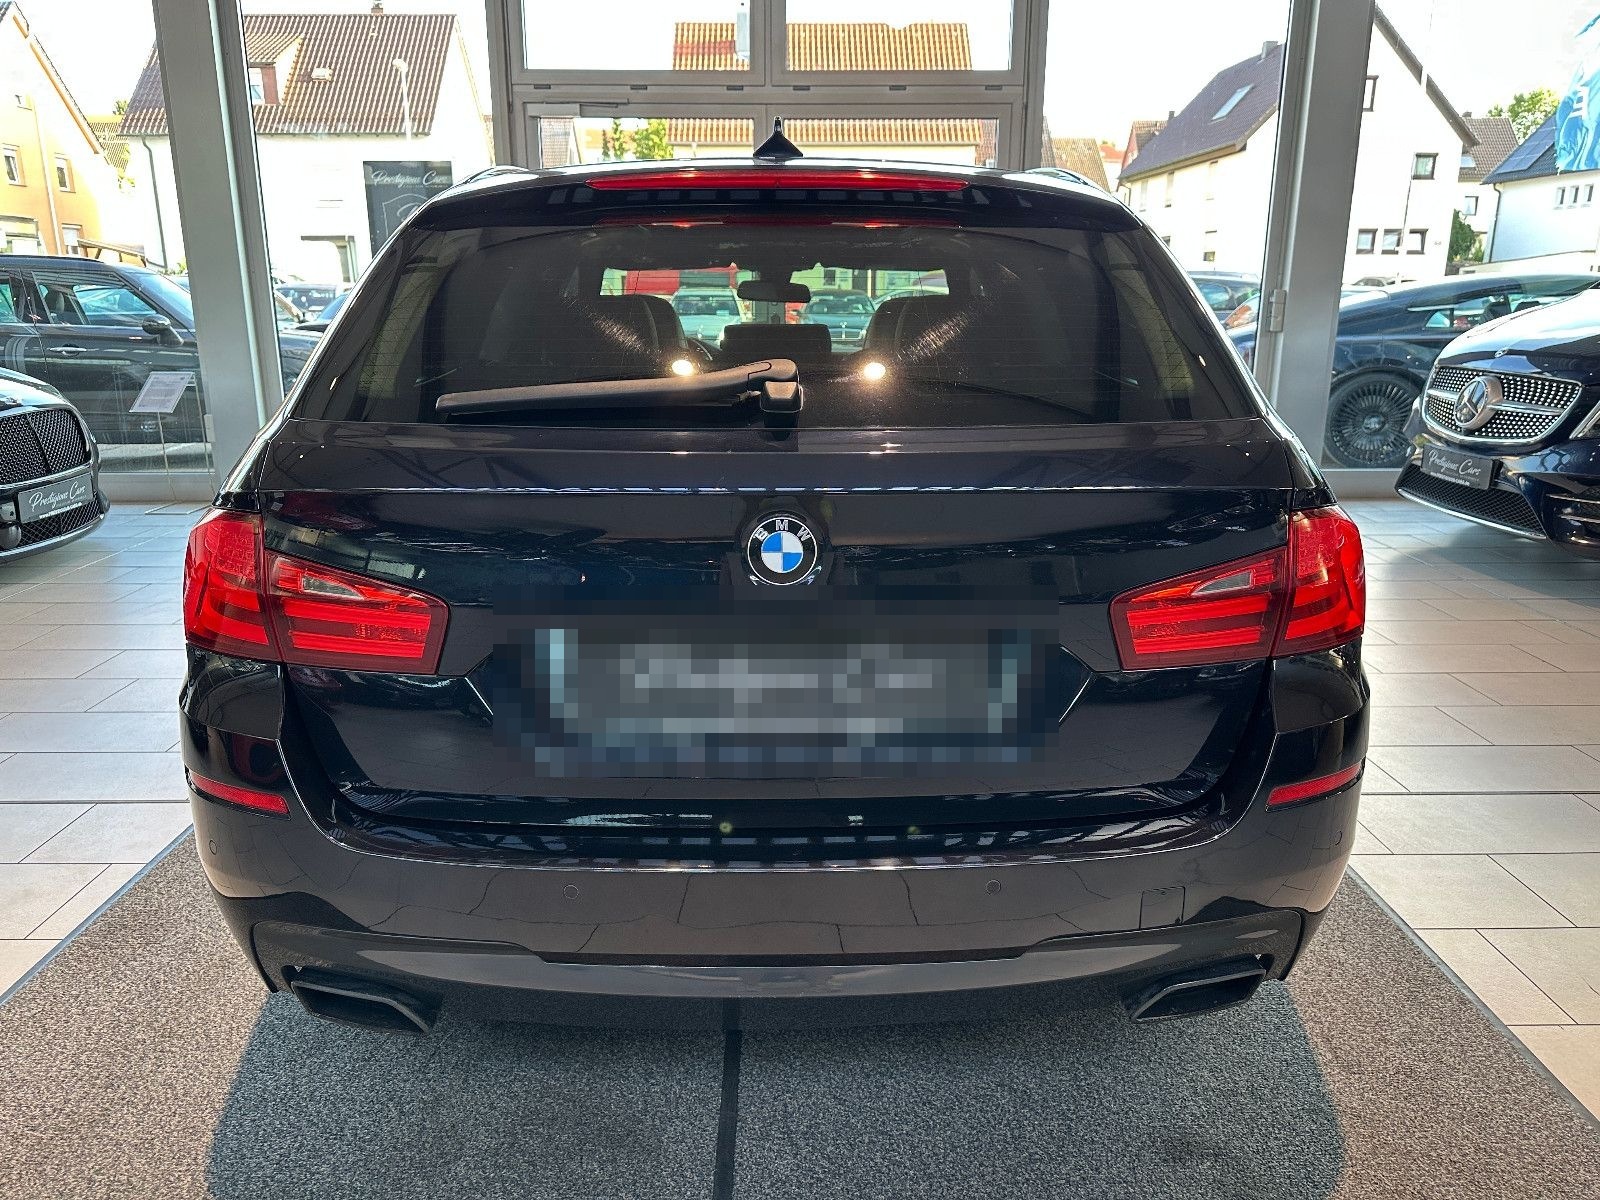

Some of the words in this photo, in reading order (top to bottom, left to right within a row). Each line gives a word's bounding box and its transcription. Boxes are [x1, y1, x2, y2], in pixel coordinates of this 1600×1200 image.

[371, 170, 421, 188] Prestigious
[423, 170, 449, 186] Cars
[1428, 449, 1459, 472] Prestigious
[1458, 459, 1481, 476] Cars
[28, 491, 69, 512] Prestigious
[69, 481, 86, 500] Cars
[753, 519, 812, 542] BMW
